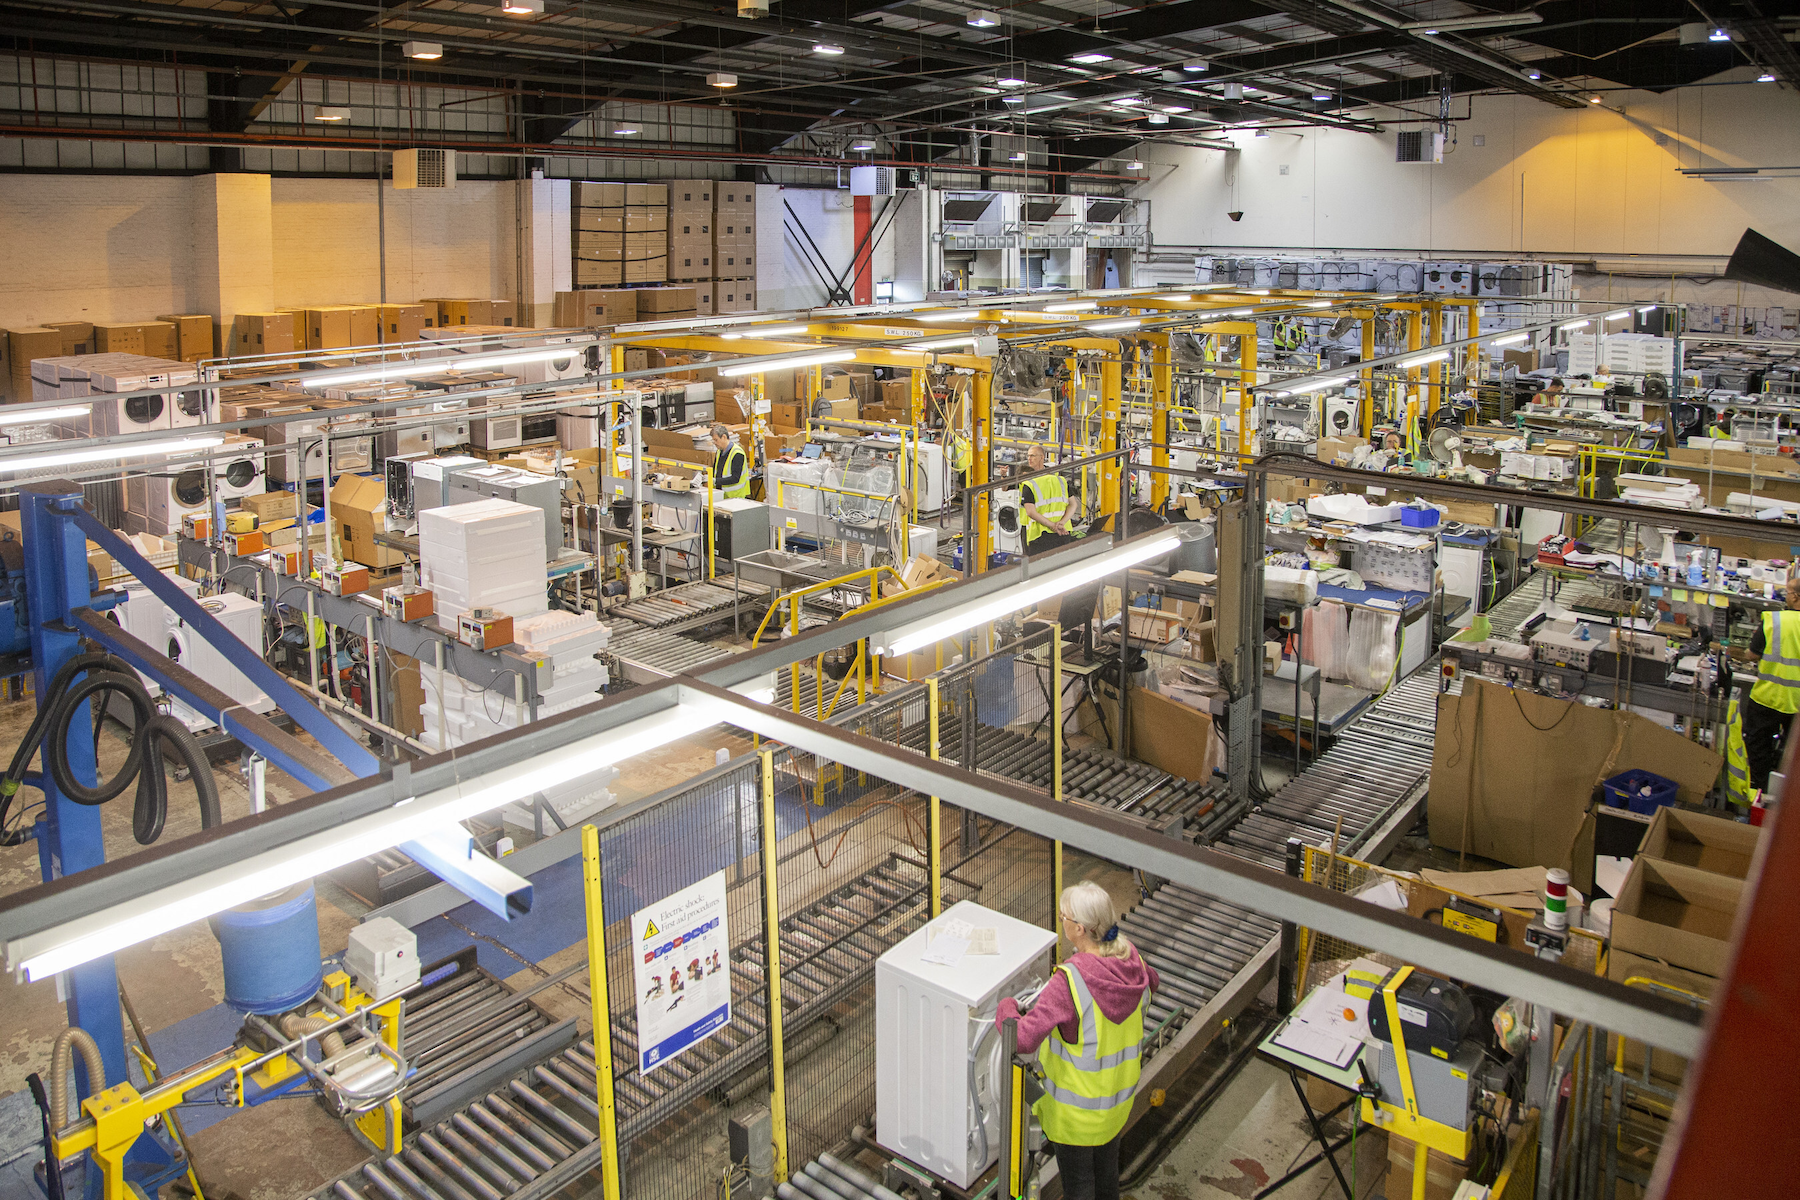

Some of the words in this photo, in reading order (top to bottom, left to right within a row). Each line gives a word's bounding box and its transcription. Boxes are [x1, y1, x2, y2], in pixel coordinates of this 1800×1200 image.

[660, 904, 684, 922] Electric
[685, 895, 705, 910] shock:
[661, 920, 676, 932] First
[676, 914, 687, 925] aid
[687, 898, 720, 921] procedures
